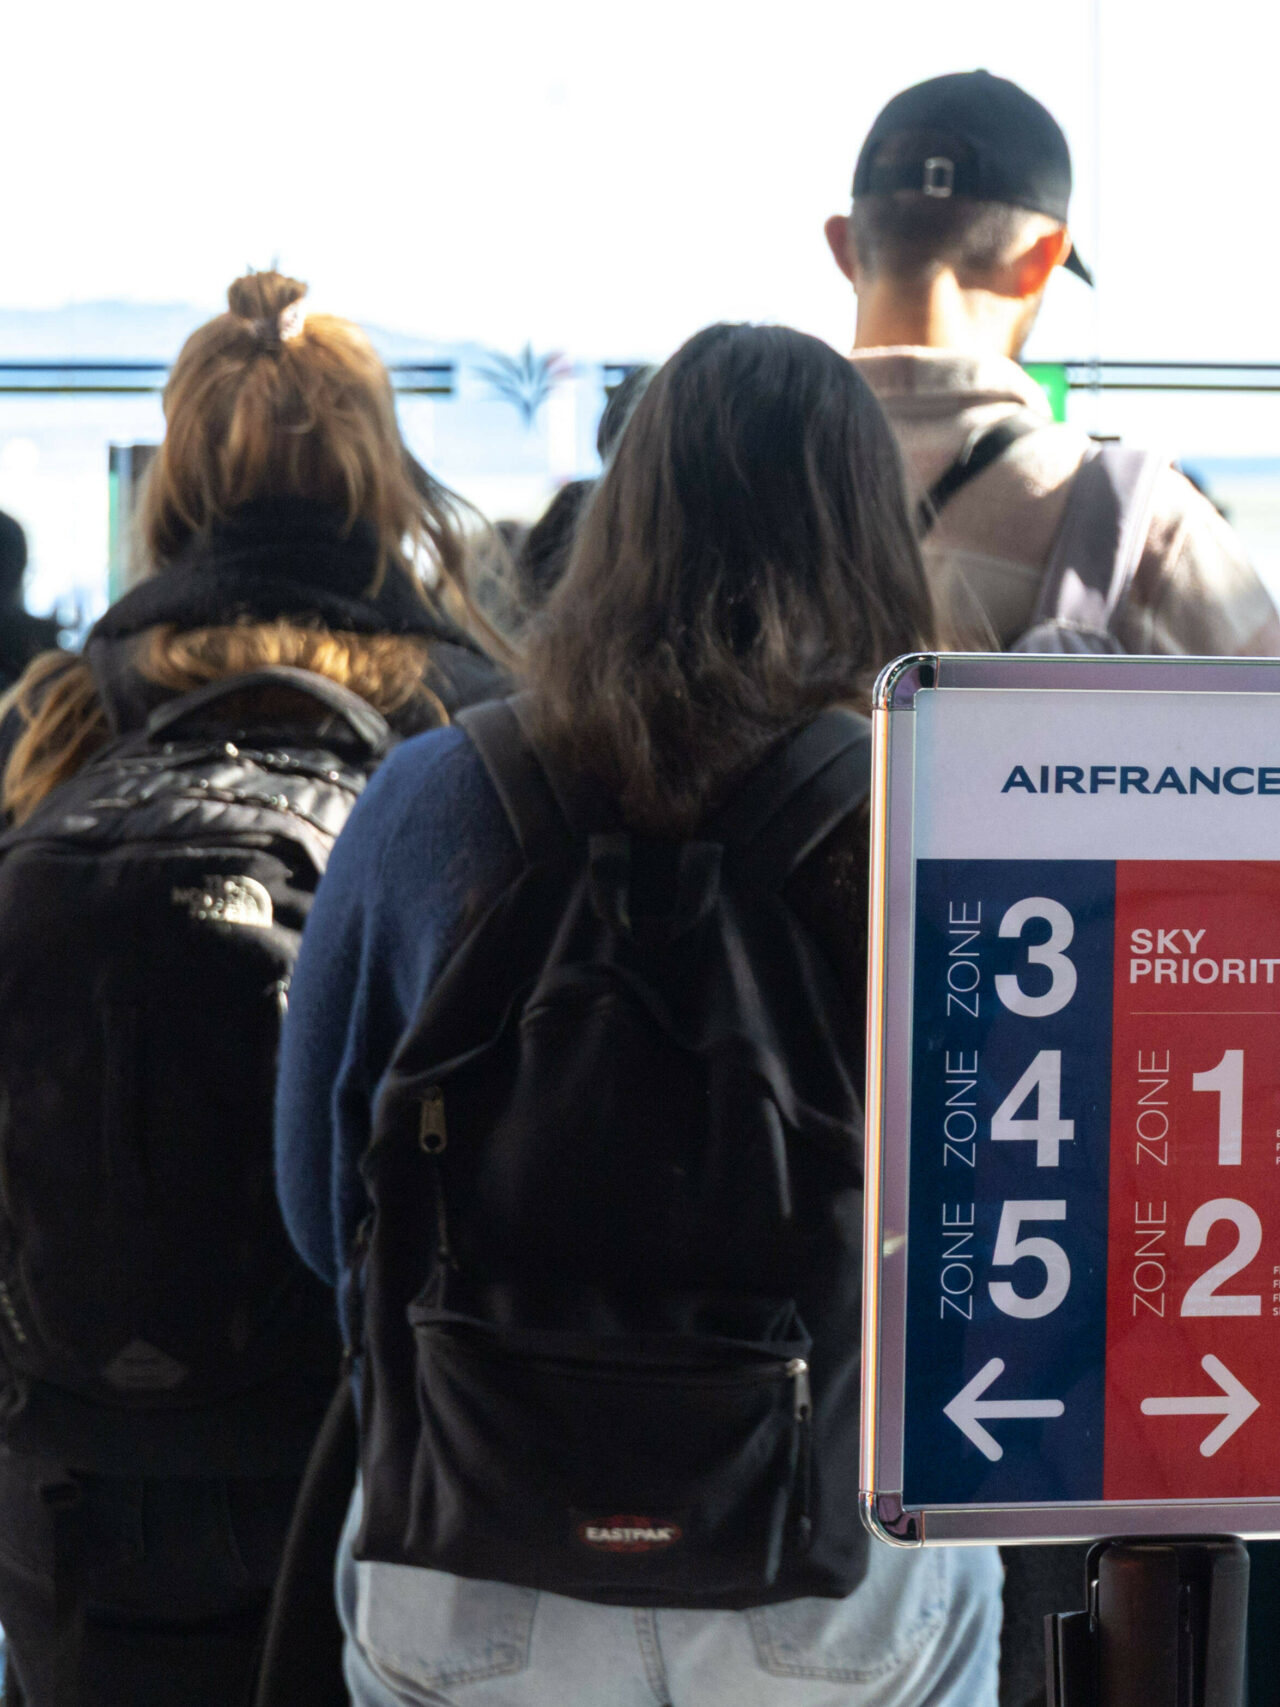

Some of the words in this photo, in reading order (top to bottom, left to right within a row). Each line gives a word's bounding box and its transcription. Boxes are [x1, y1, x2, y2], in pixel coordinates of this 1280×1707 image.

[947, 901, 981, 1018] ZONE
[994, 896, 1078, 1018] 3
[1130, 928, 1206, 955] SKY
[943, 1050, 978, 1168] ZONE
[990, 1049, 1075, 1168] 4
[1136, 1049, 1170, 1166] ZONE
[1192, 1049, 1245, 1166] 1
[940, 1202, 975, 1321] ZONE
[988, 1199, 1071, 1320] 5
[1132, 1200, 1167, 1318] ZONE
[1180, 1197, 1263, 1318] 2
[585, 1526, 676, 1542] EASTPAK
